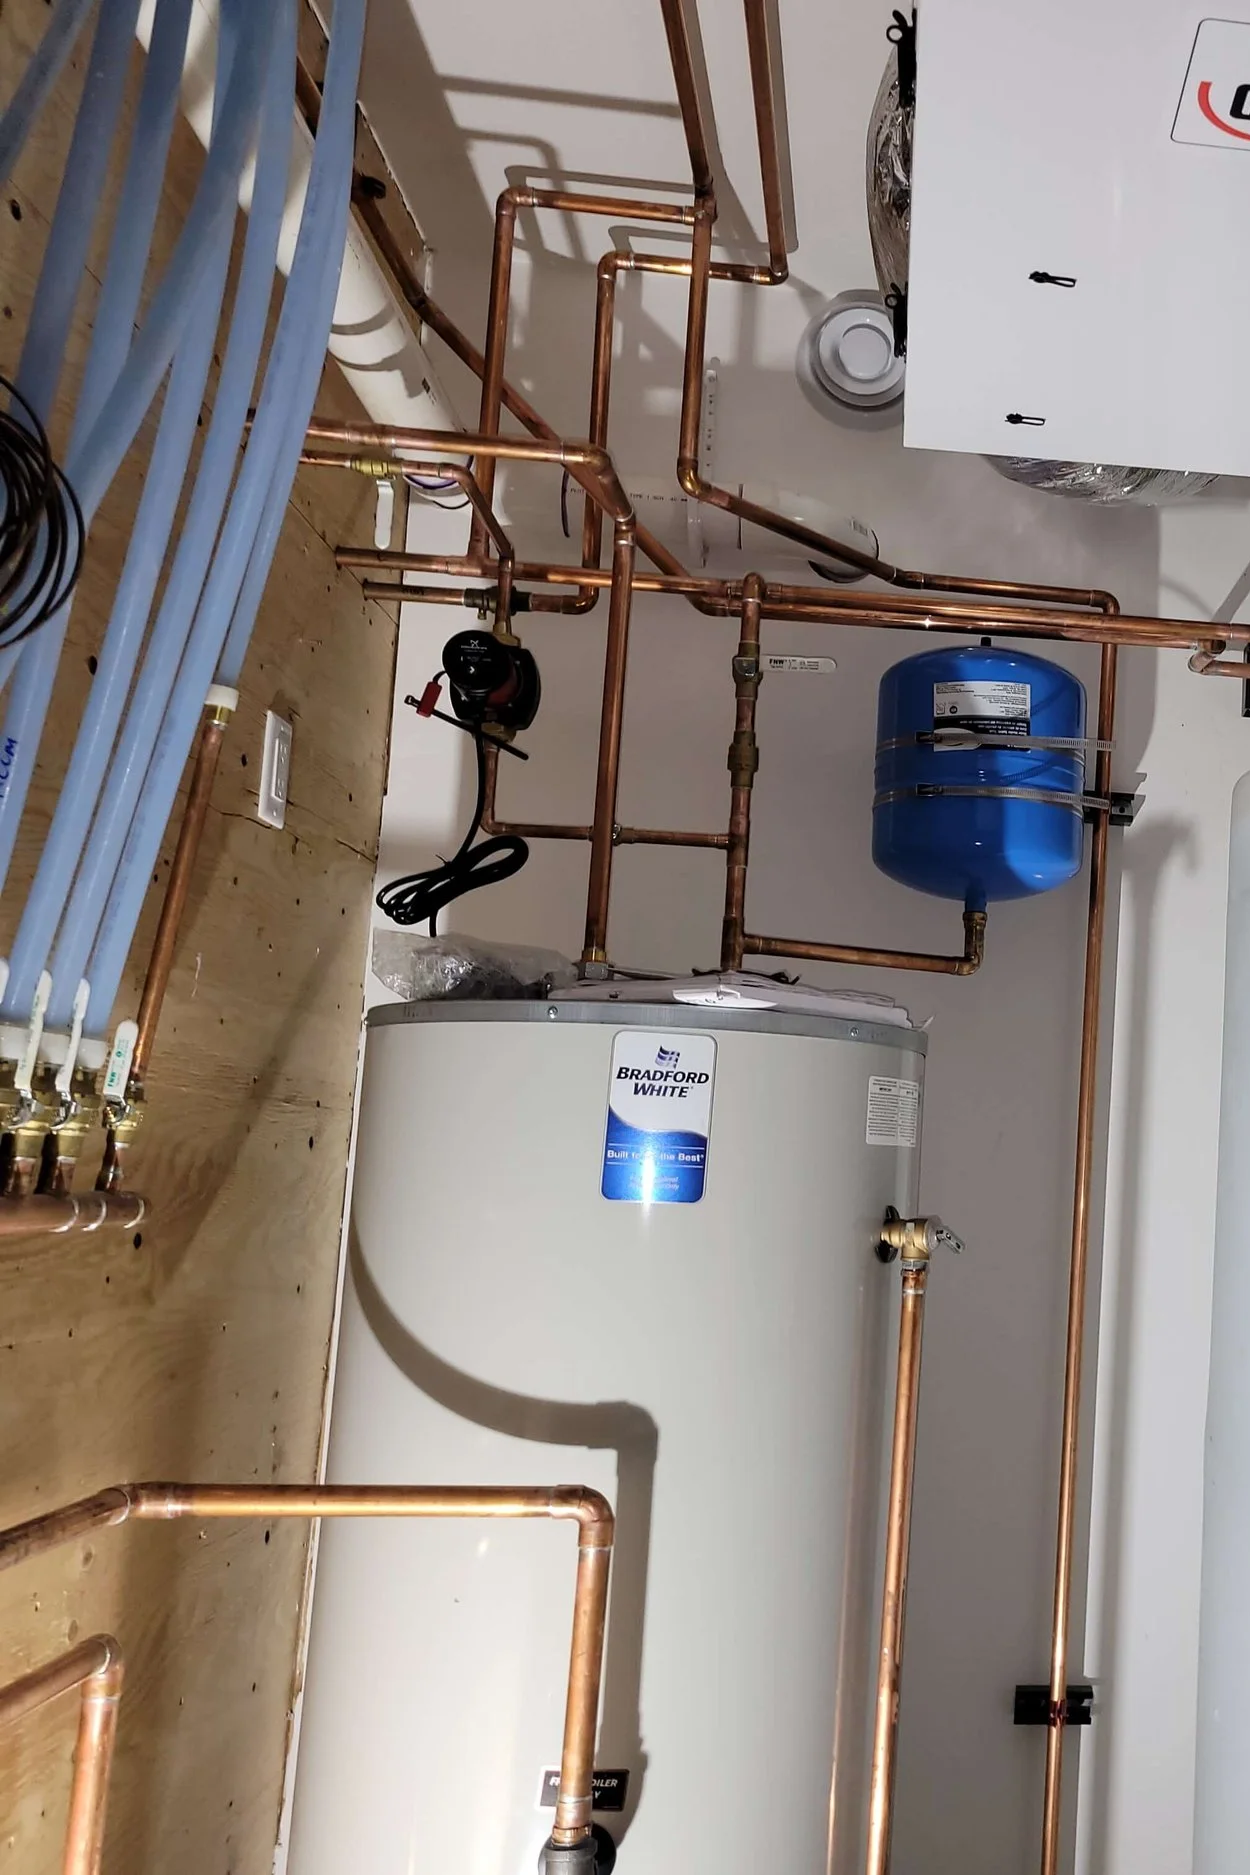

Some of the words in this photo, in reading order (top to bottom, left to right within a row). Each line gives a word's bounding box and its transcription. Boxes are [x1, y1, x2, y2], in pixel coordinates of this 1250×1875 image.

[616, 1067, 710, 1084] BRADFORD
[633, 1082, 690, 1098] WHITE
[607, 1150, 628, 1160] Built
[591, 1779, 618, 1788] OILER
